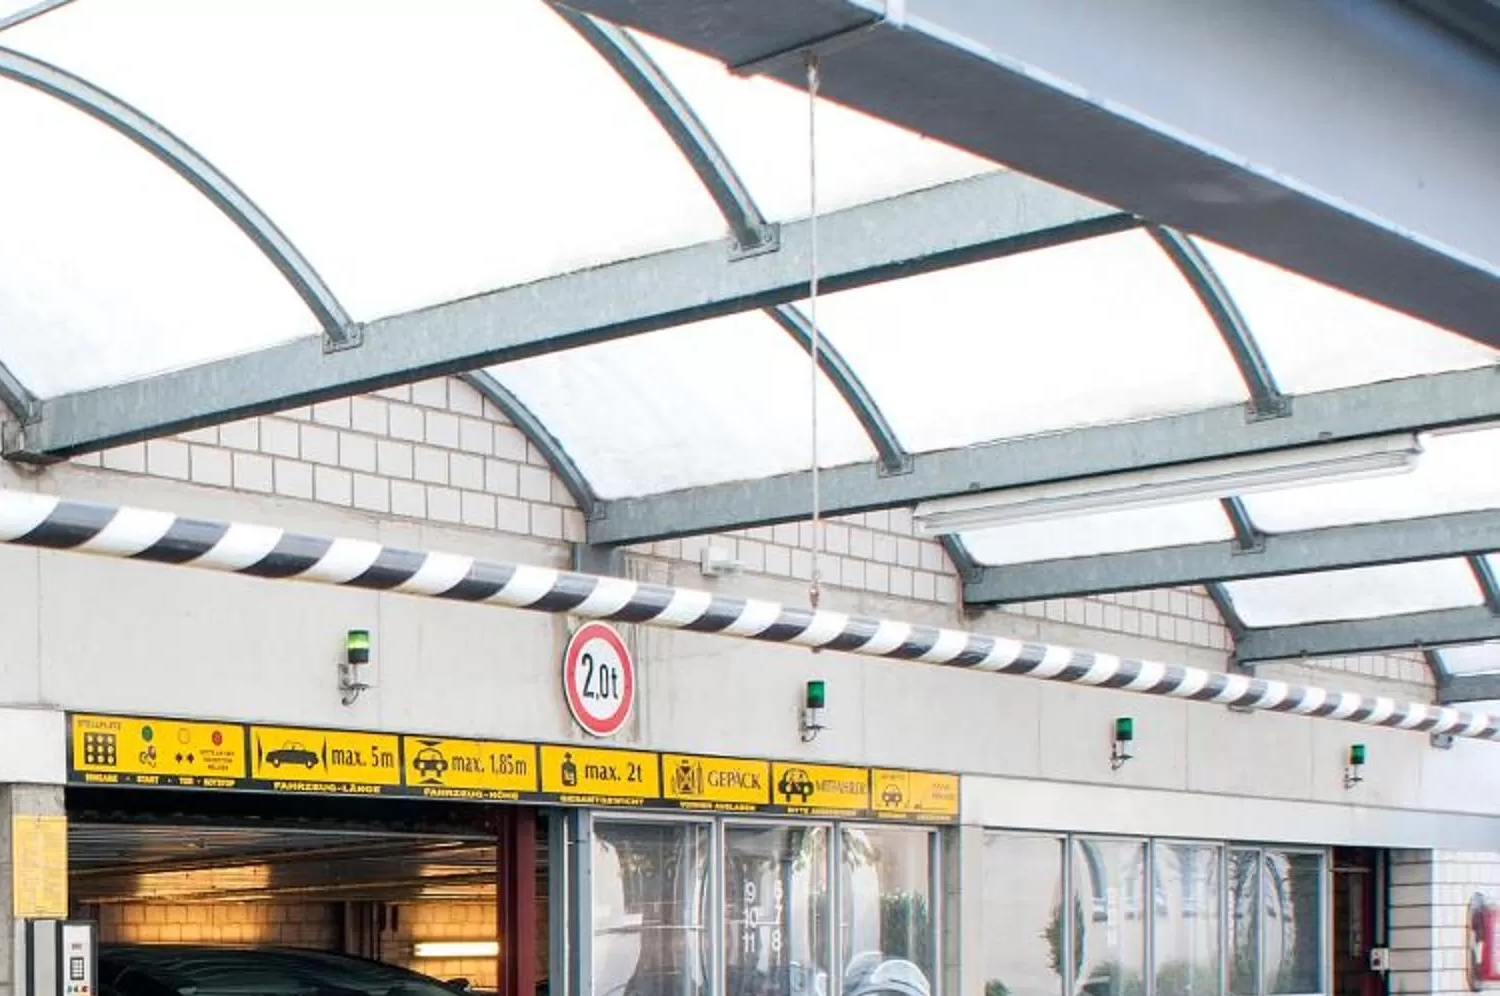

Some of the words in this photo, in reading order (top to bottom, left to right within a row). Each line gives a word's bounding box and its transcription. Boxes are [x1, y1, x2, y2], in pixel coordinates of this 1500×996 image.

[332, 748, 367, 767] max.
[451, 755, 485, 773] max.
[585, 765, 621, 781] max.
[627, 762, 643, 782] 2t
[707, 768, 761, 790] GEPÄCK
[744, 881, 757, 903] 9
[742, 907, 758, 928] 10
[772, 929, 781, 952] 8
